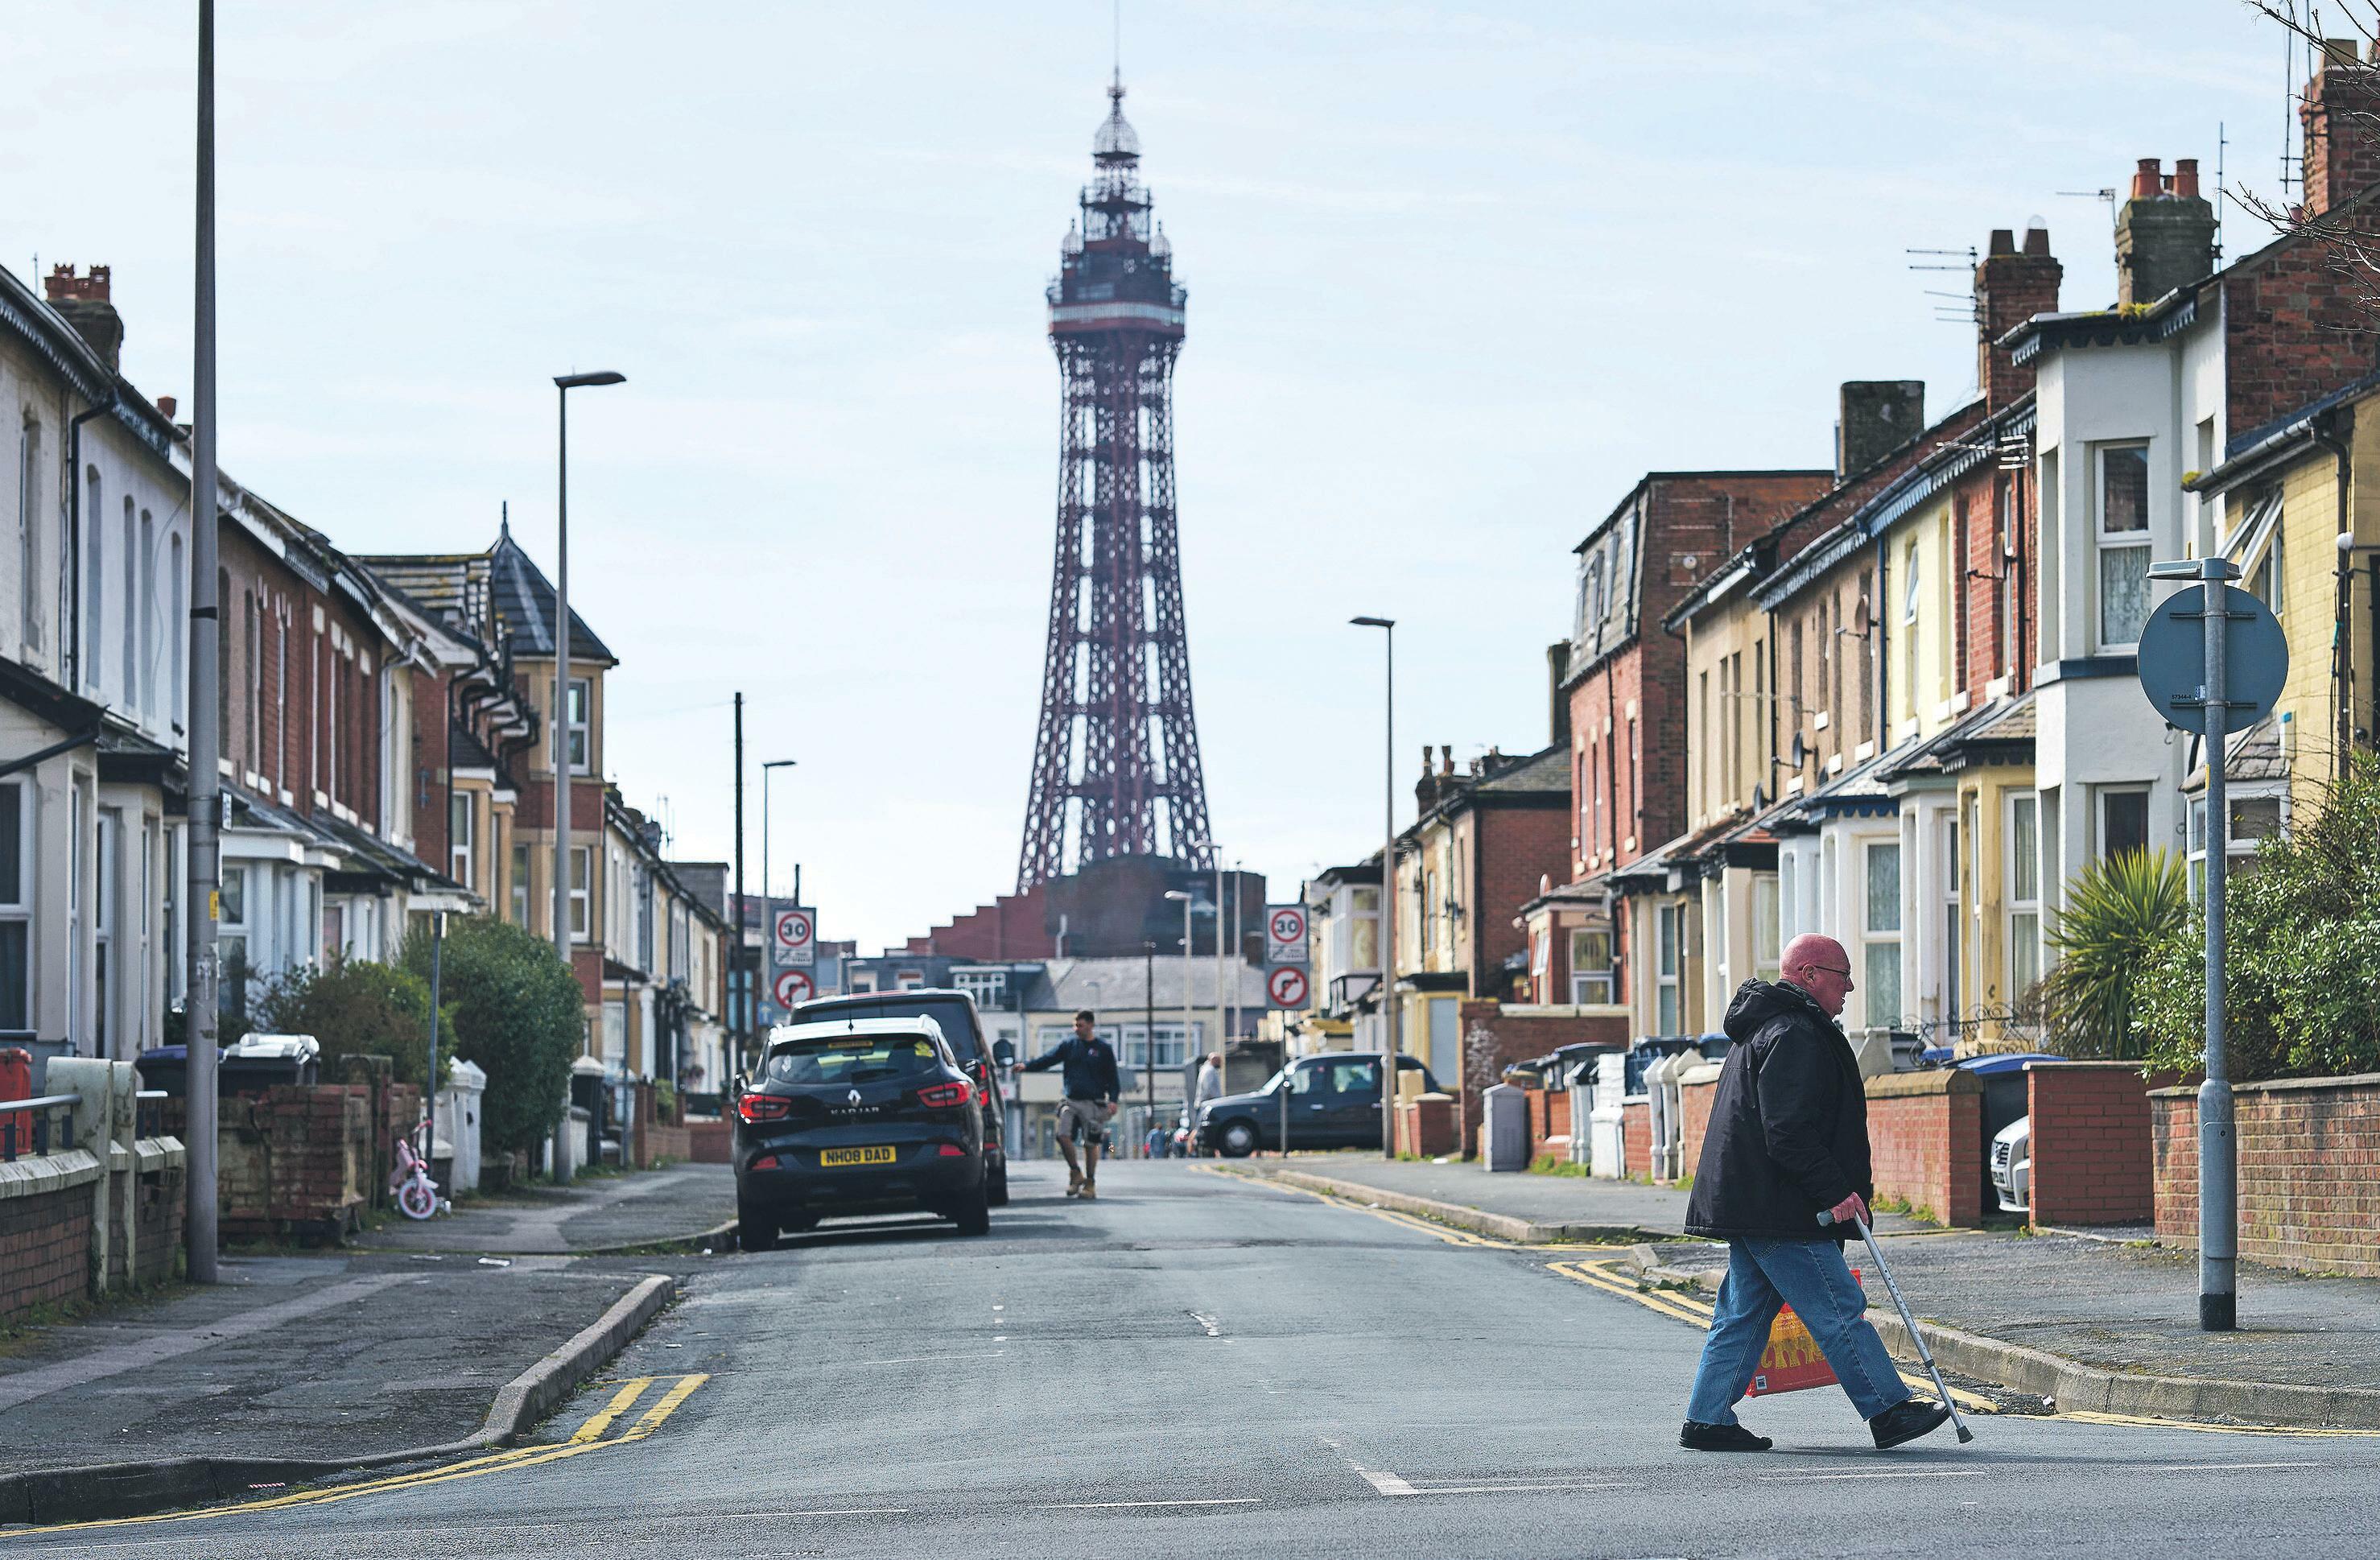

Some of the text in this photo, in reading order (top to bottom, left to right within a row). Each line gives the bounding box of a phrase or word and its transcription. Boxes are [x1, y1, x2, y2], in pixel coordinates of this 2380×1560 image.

[782, 922, 805, 937] 30
[1277, 919, 1297, 934] 30
[827, 1148, 890, 1164] NH08 DAD
